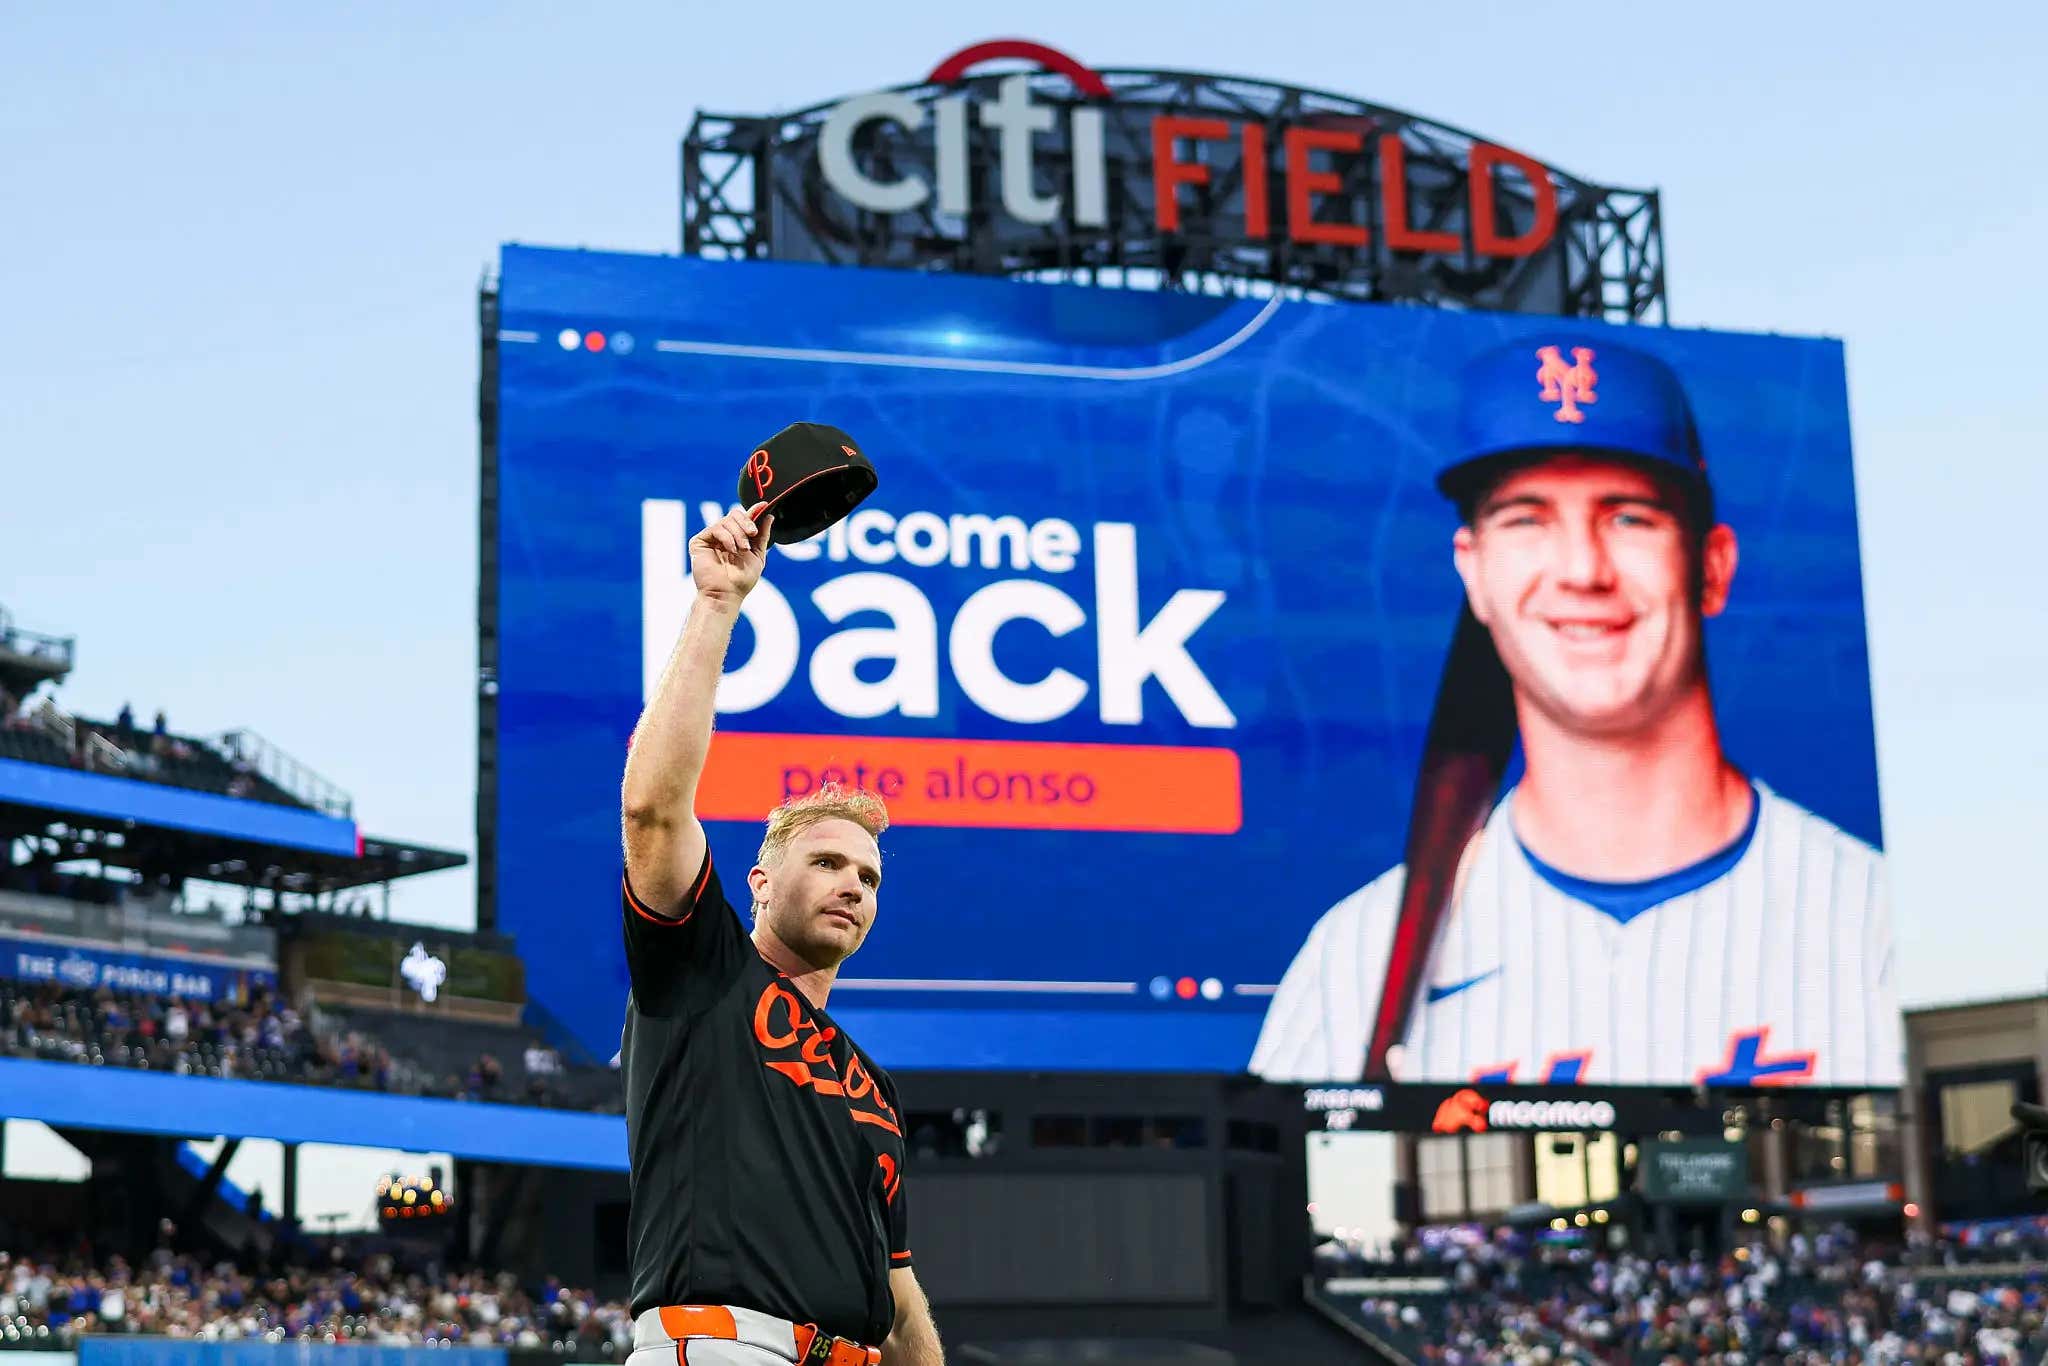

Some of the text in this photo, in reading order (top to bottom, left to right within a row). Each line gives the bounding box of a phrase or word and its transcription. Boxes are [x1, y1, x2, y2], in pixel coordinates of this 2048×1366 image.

[818, 74, 1558, 259] citi FIELD
[748, 449, 773, 499] B
[641, 498, 1237, 729] back
[783, 756, 1096, 808] pete alonso
[1488, 1100, 1616, 1128] moomoo
[810, 1335, 831, 1358] 25
